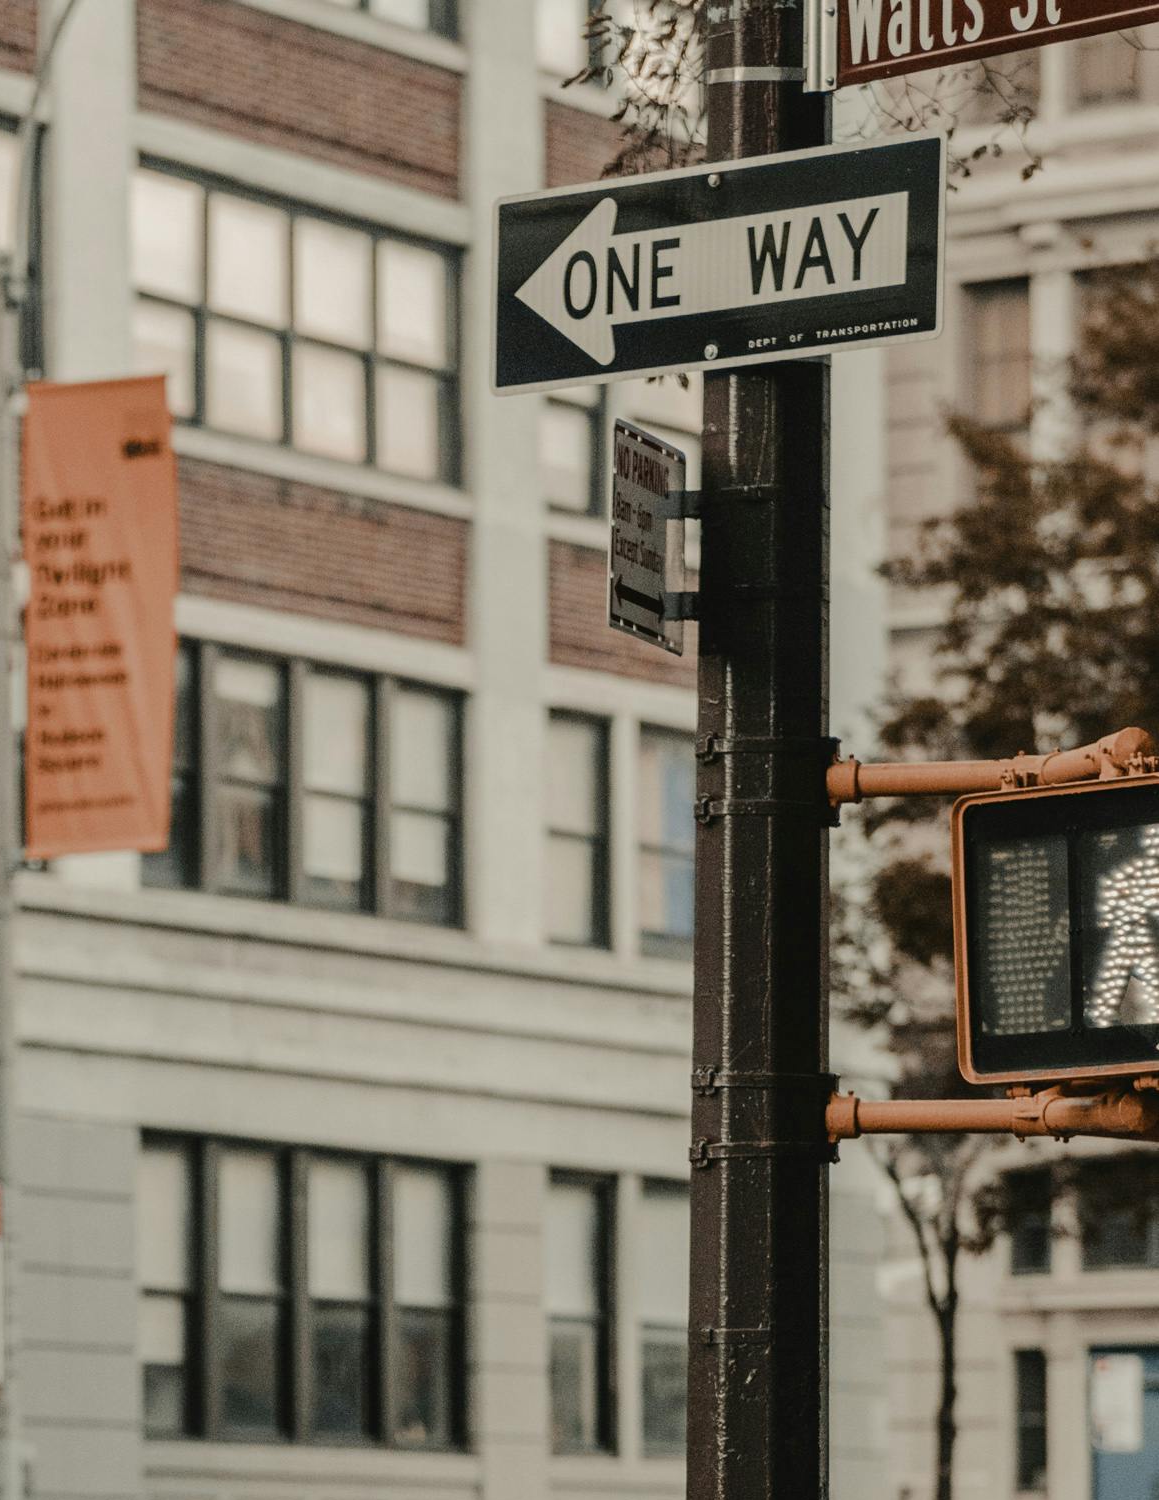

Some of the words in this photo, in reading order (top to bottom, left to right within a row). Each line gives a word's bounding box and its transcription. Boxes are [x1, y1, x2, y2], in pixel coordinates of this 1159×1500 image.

[564, 237, 680, 320] ONE
[747, 207, 880, 295] WAY
[748, 337, 777, 348] DEPT
[789, 333, 804, 343] OF
[815, 318, 919, 339] TRANSPORTATION
[616, 443, 629, 480] NO
[632, 450, 669, 499] PARKING
[615, 528, 638, 567] Except
